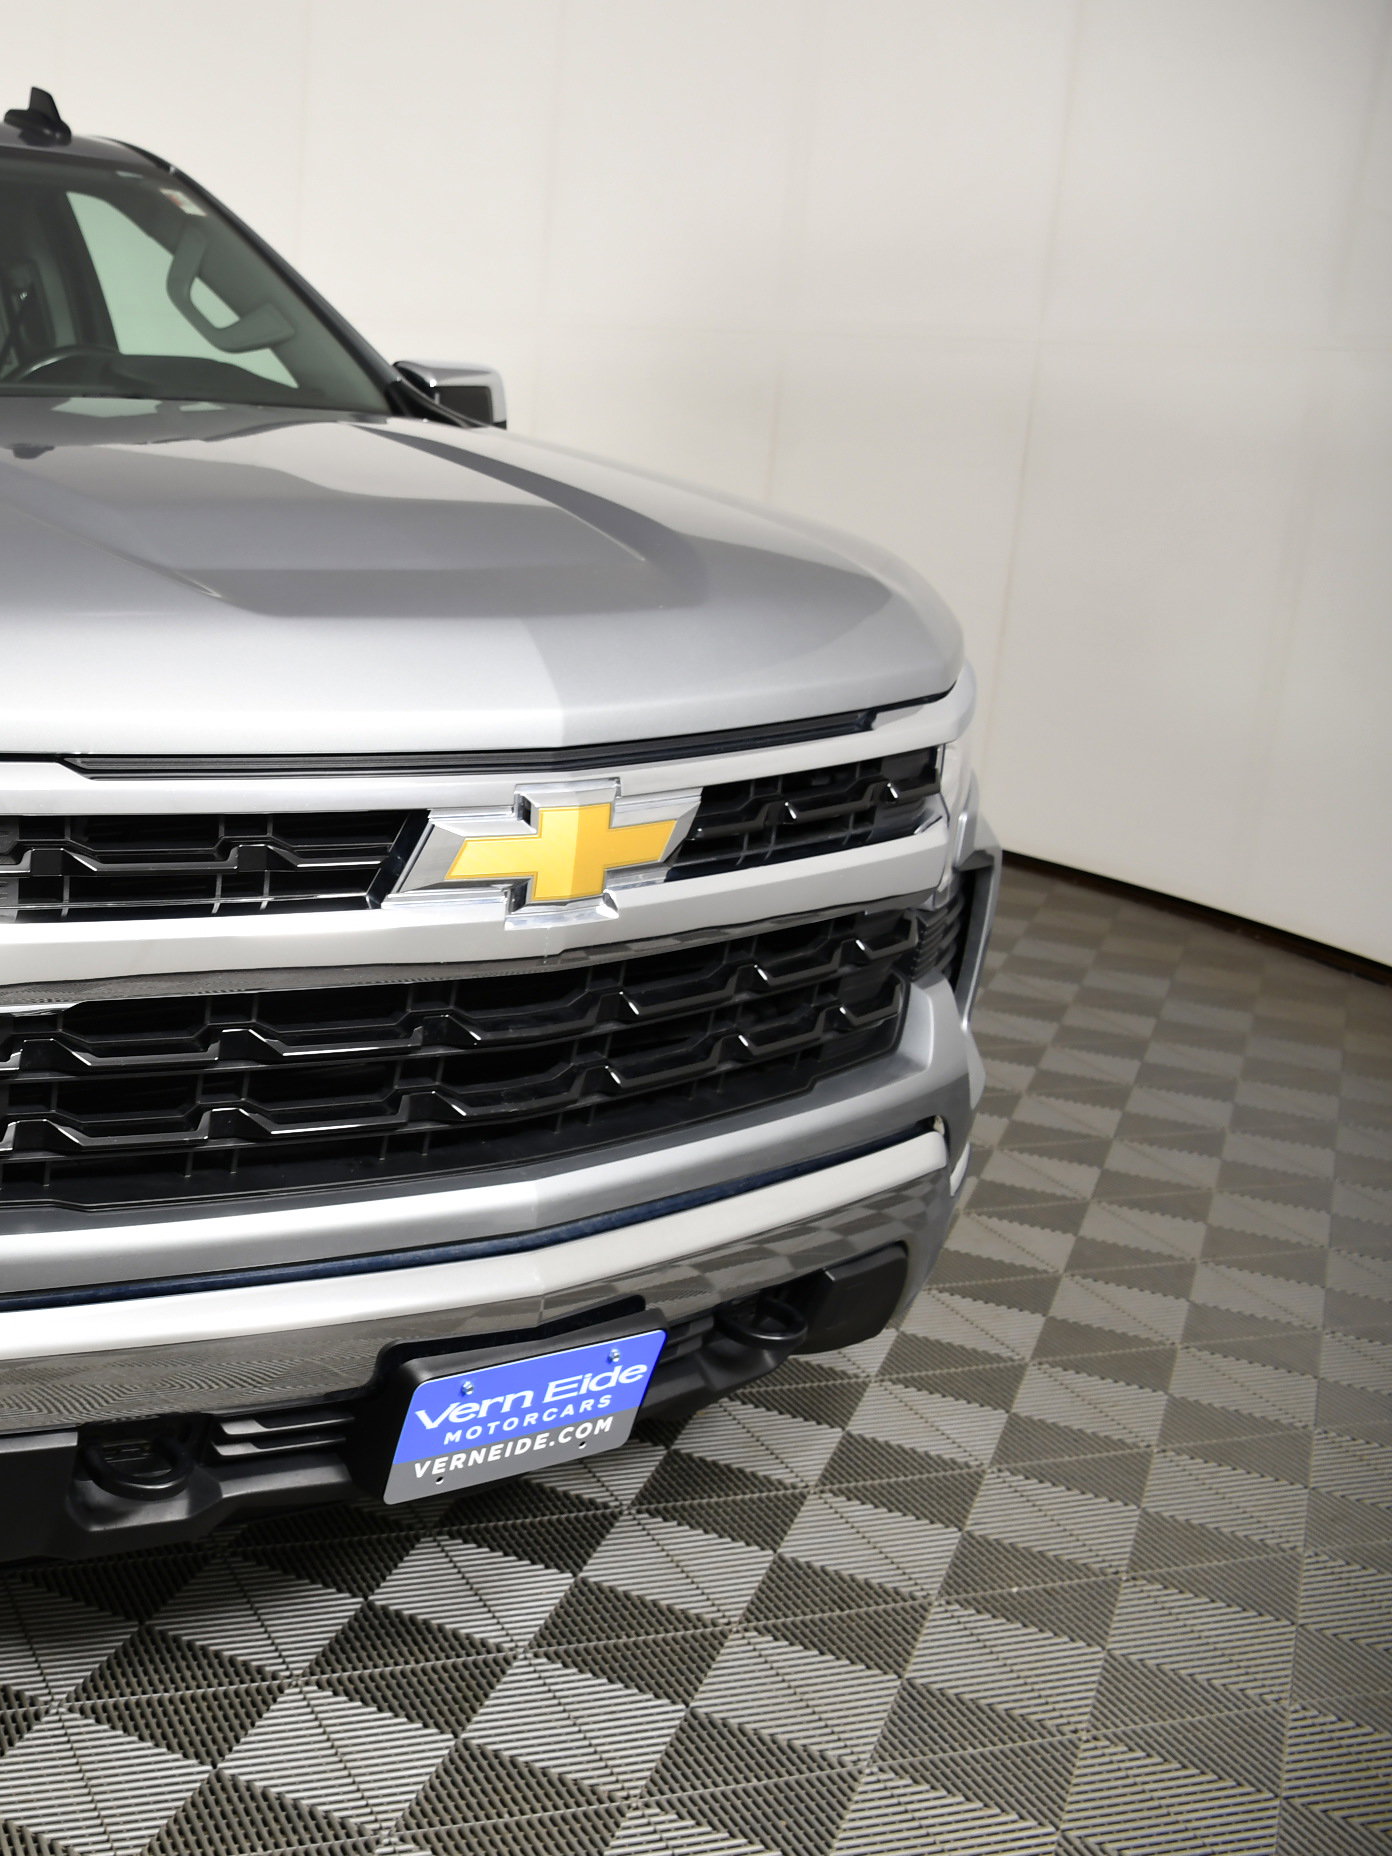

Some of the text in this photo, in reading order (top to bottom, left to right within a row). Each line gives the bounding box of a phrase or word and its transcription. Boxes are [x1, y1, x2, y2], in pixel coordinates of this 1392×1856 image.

[416, 1364, 647, 1430] Vern Eide
[444, 1395, 612, 1445] MOTORCARS
[414, 1417, 613, 1478] VERNEIDE.COM
